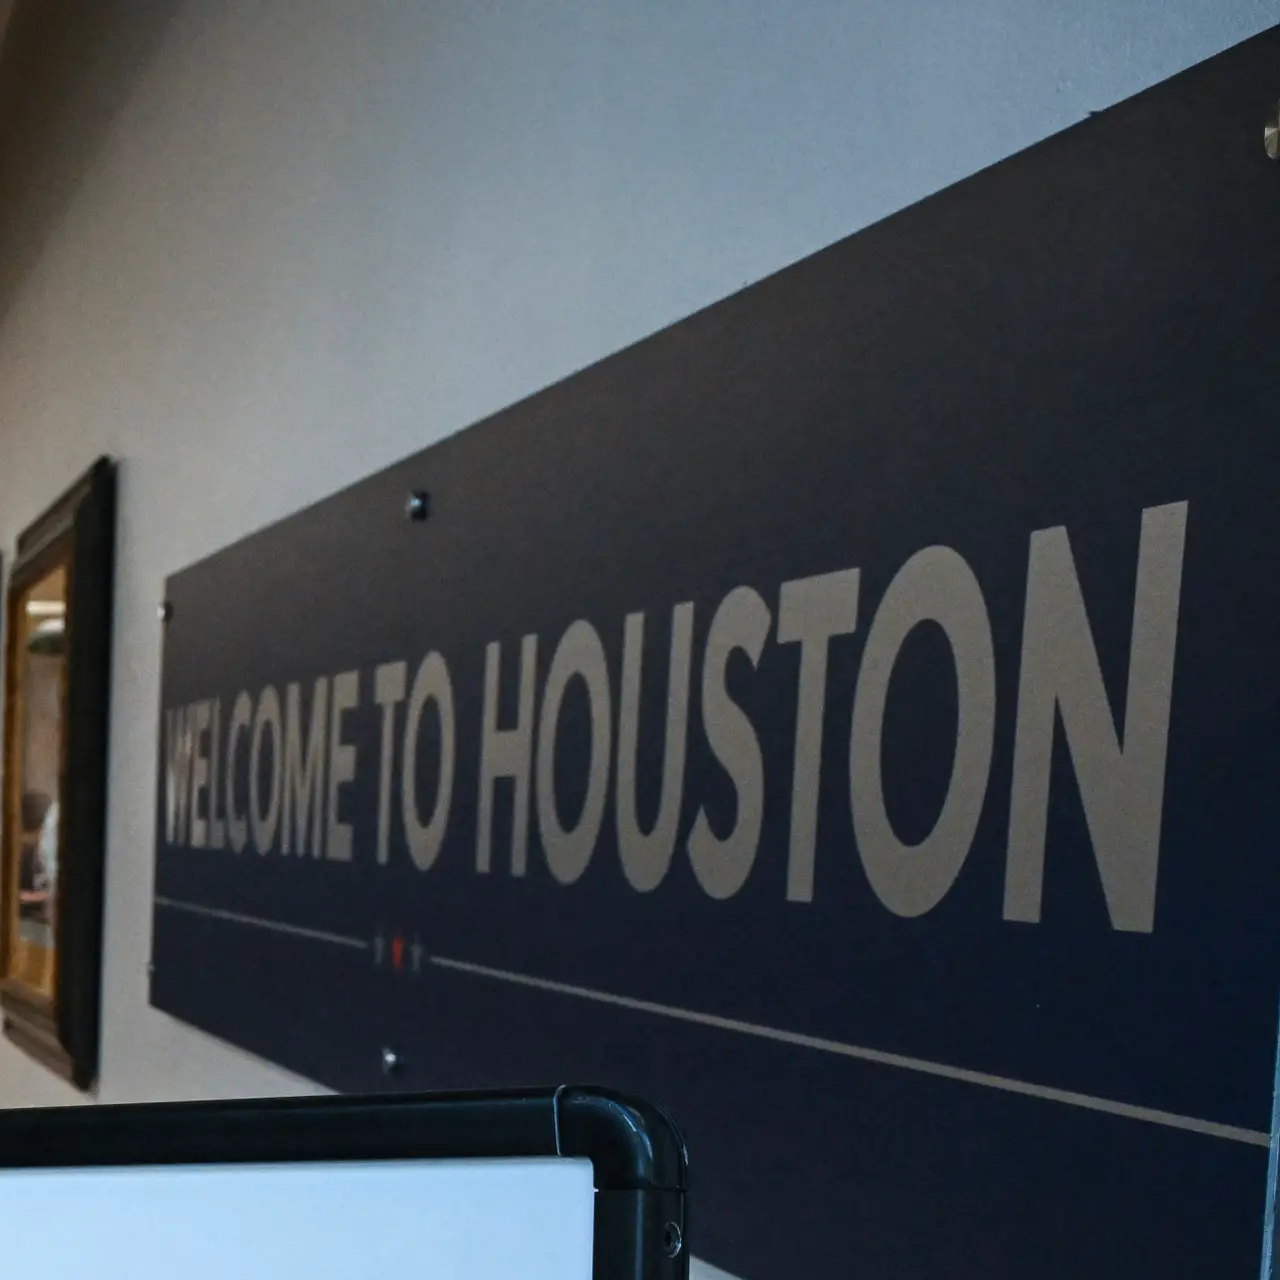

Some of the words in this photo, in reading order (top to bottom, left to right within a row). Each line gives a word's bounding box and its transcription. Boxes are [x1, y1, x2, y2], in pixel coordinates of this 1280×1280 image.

[165, 670, 359, 862] WELCOME
[374, 650, 455, 872] TO
[475, 500, 1188, 933] HOUSTON
